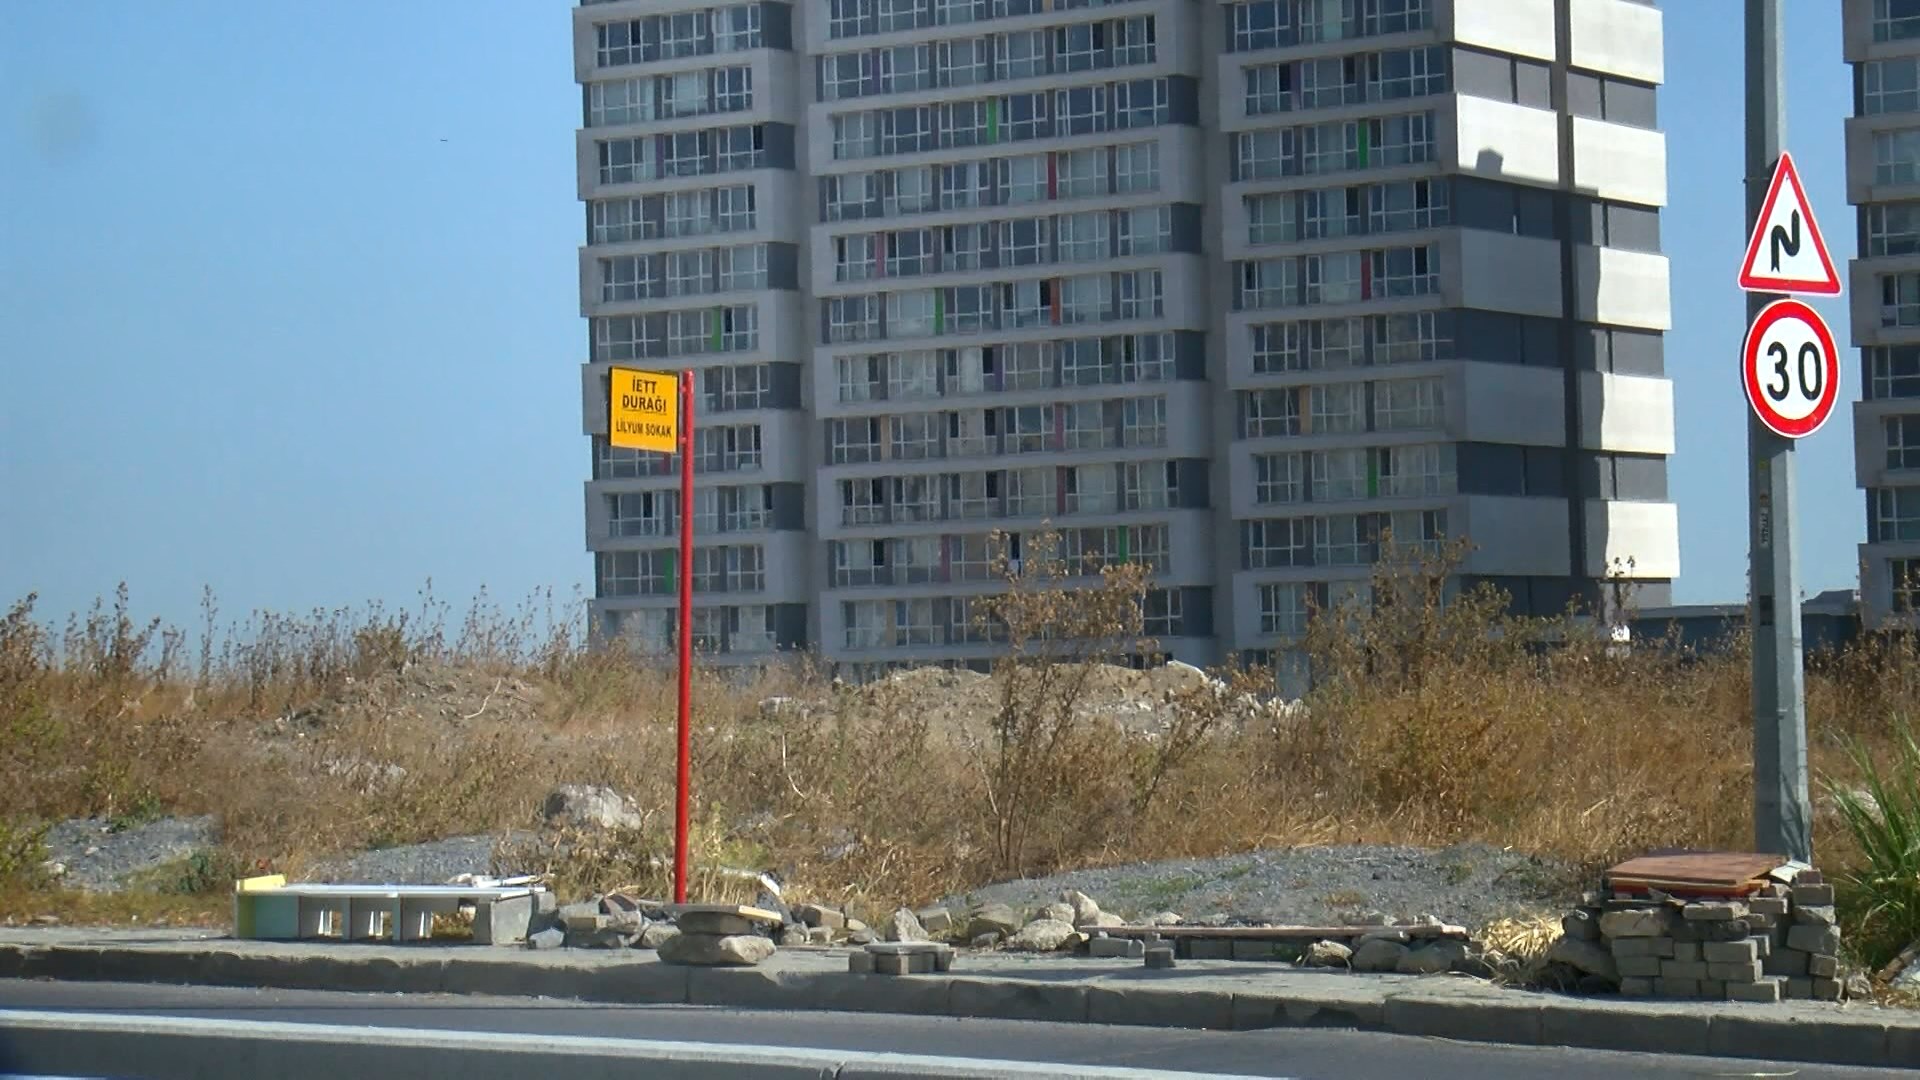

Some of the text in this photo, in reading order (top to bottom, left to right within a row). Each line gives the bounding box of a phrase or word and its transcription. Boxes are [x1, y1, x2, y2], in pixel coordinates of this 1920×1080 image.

[1766, 341, 1823, 402] 30
[632, 375, 657, 394] İETT
[622, 395, 667, 413] DURAĞI
[645, 422, 672, 439] SOKAK
